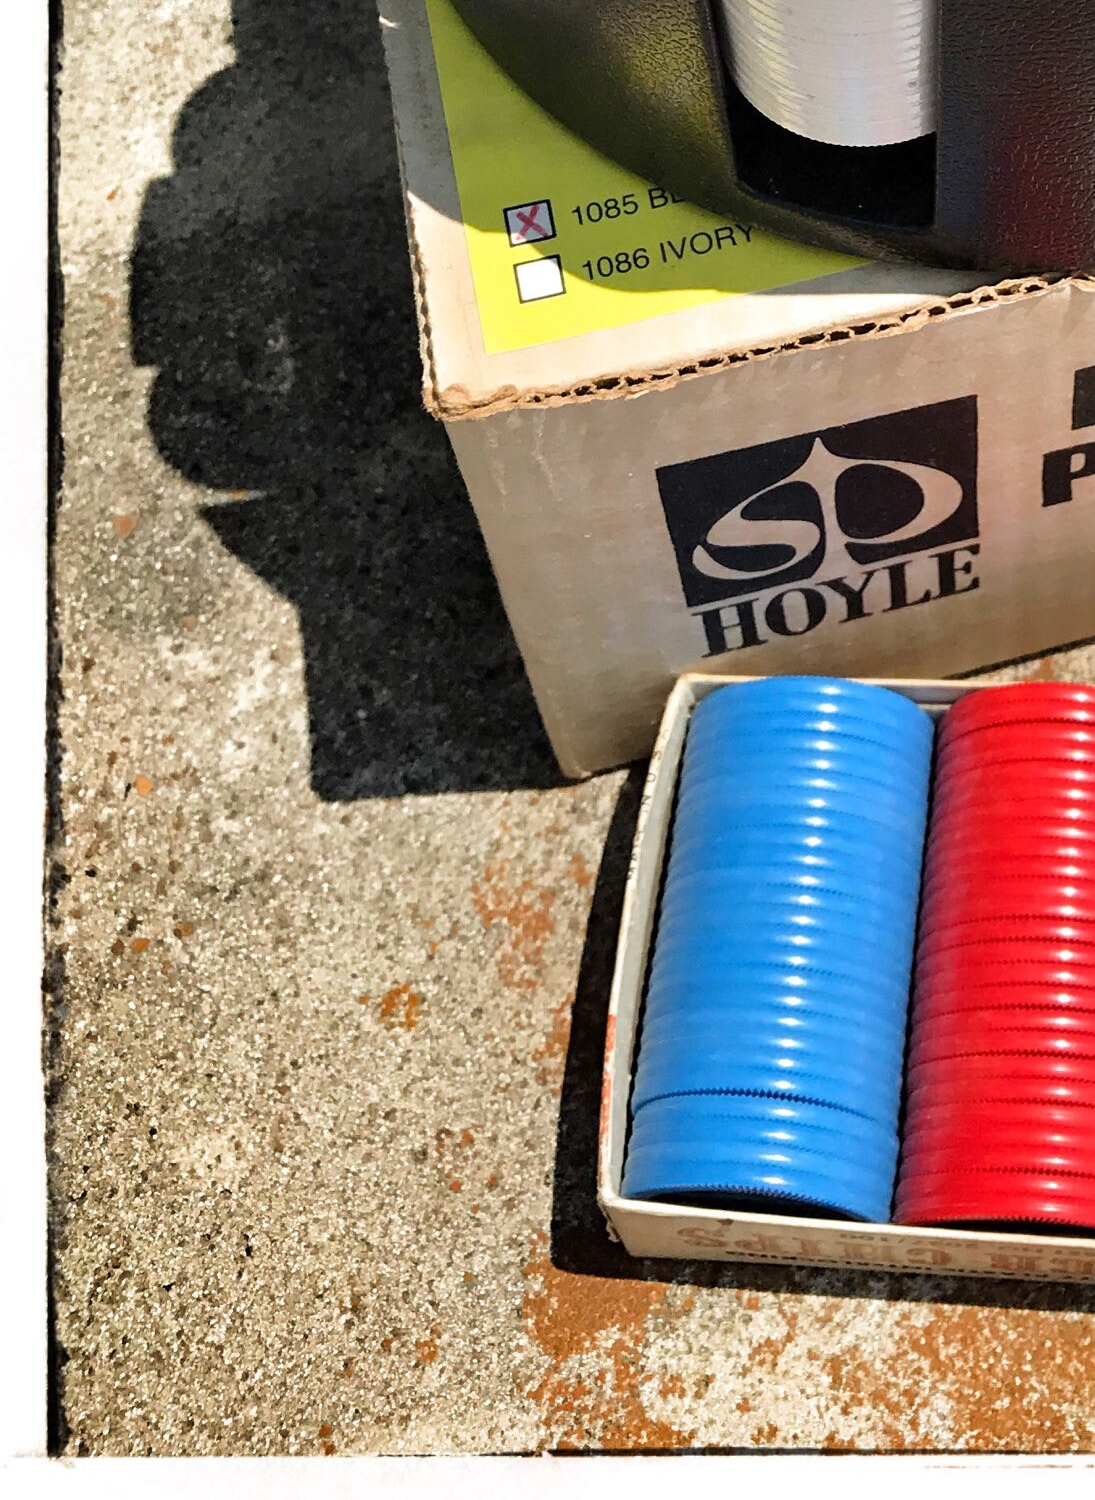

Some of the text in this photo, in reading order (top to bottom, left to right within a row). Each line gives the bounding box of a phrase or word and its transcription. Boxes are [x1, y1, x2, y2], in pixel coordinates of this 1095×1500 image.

[571, 187, 687, 226] 1085 BL
[582, 223, 754, 281] 1086 IVORY
[690, 542, 981, 659] HOYLE
[676, 1225, 953, 1266] CHIPS
